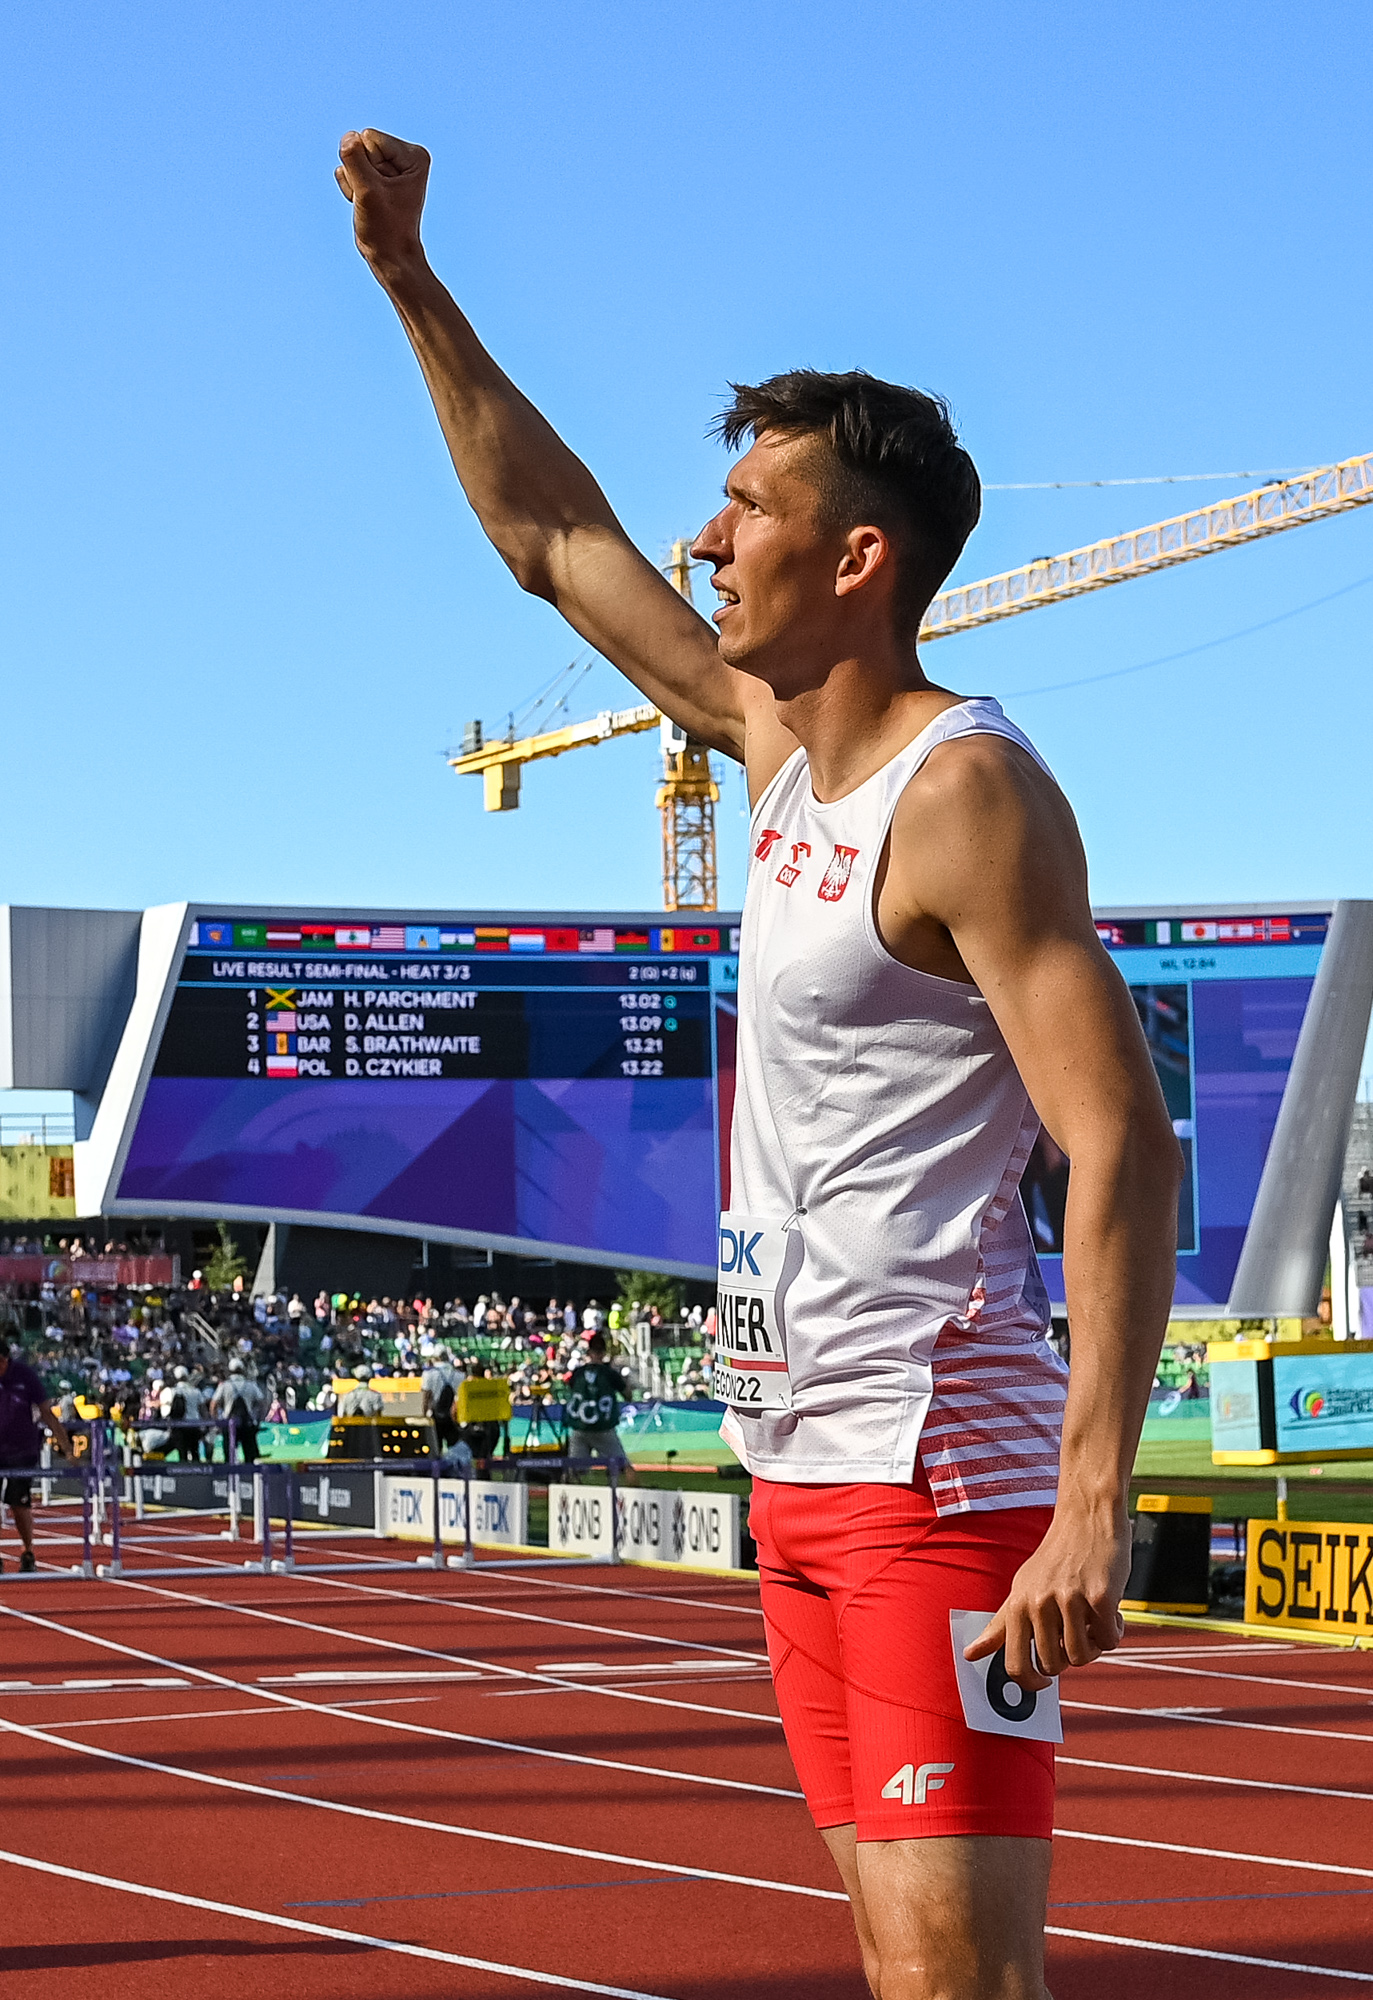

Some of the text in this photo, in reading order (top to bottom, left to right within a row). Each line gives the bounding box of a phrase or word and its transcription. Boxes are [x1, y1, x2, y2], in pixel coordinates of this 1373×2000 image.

[213, 961, 245, 977] LIVE
[247, 962, 303, 978] RESULT
[305, 963, 389, 979] SEMI-FINAL
[400, 964, 441, 979] HEAT
[443, 964, 471, 979] 3/3
[247, 989, 257, 1007] 1
[296, 991, 334, 1008] JAM
[364, 991, 477, 1009] PARCHMENT
[618, 993, 661, 1009] 13.02
[246, 1012, 424, 1031] 2 USA D. ALLEN
[619, 1016, 662, 1032] 13.09
[246, 1034, 259, 1053] 3
[297, 1036, 331, 1053] BAR
[363, 1035, 481, 1054] BRATHWAITE
[623, 1038, 663, 1054] 13.21
[247, 1058, 260, 1075] 4
[298, 1058, 332, 1076] POL
[365, 1058, 443, 1076] CZYKIER
[620, 1060, 663, 1076] 13.22
[716, 1292, 773, 1353] KIER
[572, 1498, 602, 1540] QNB
[630, 1501, 661, 1546] QNB
[688, 1506, 721, 1553] QNB
[881, 1763, 956, 1805] 4F
